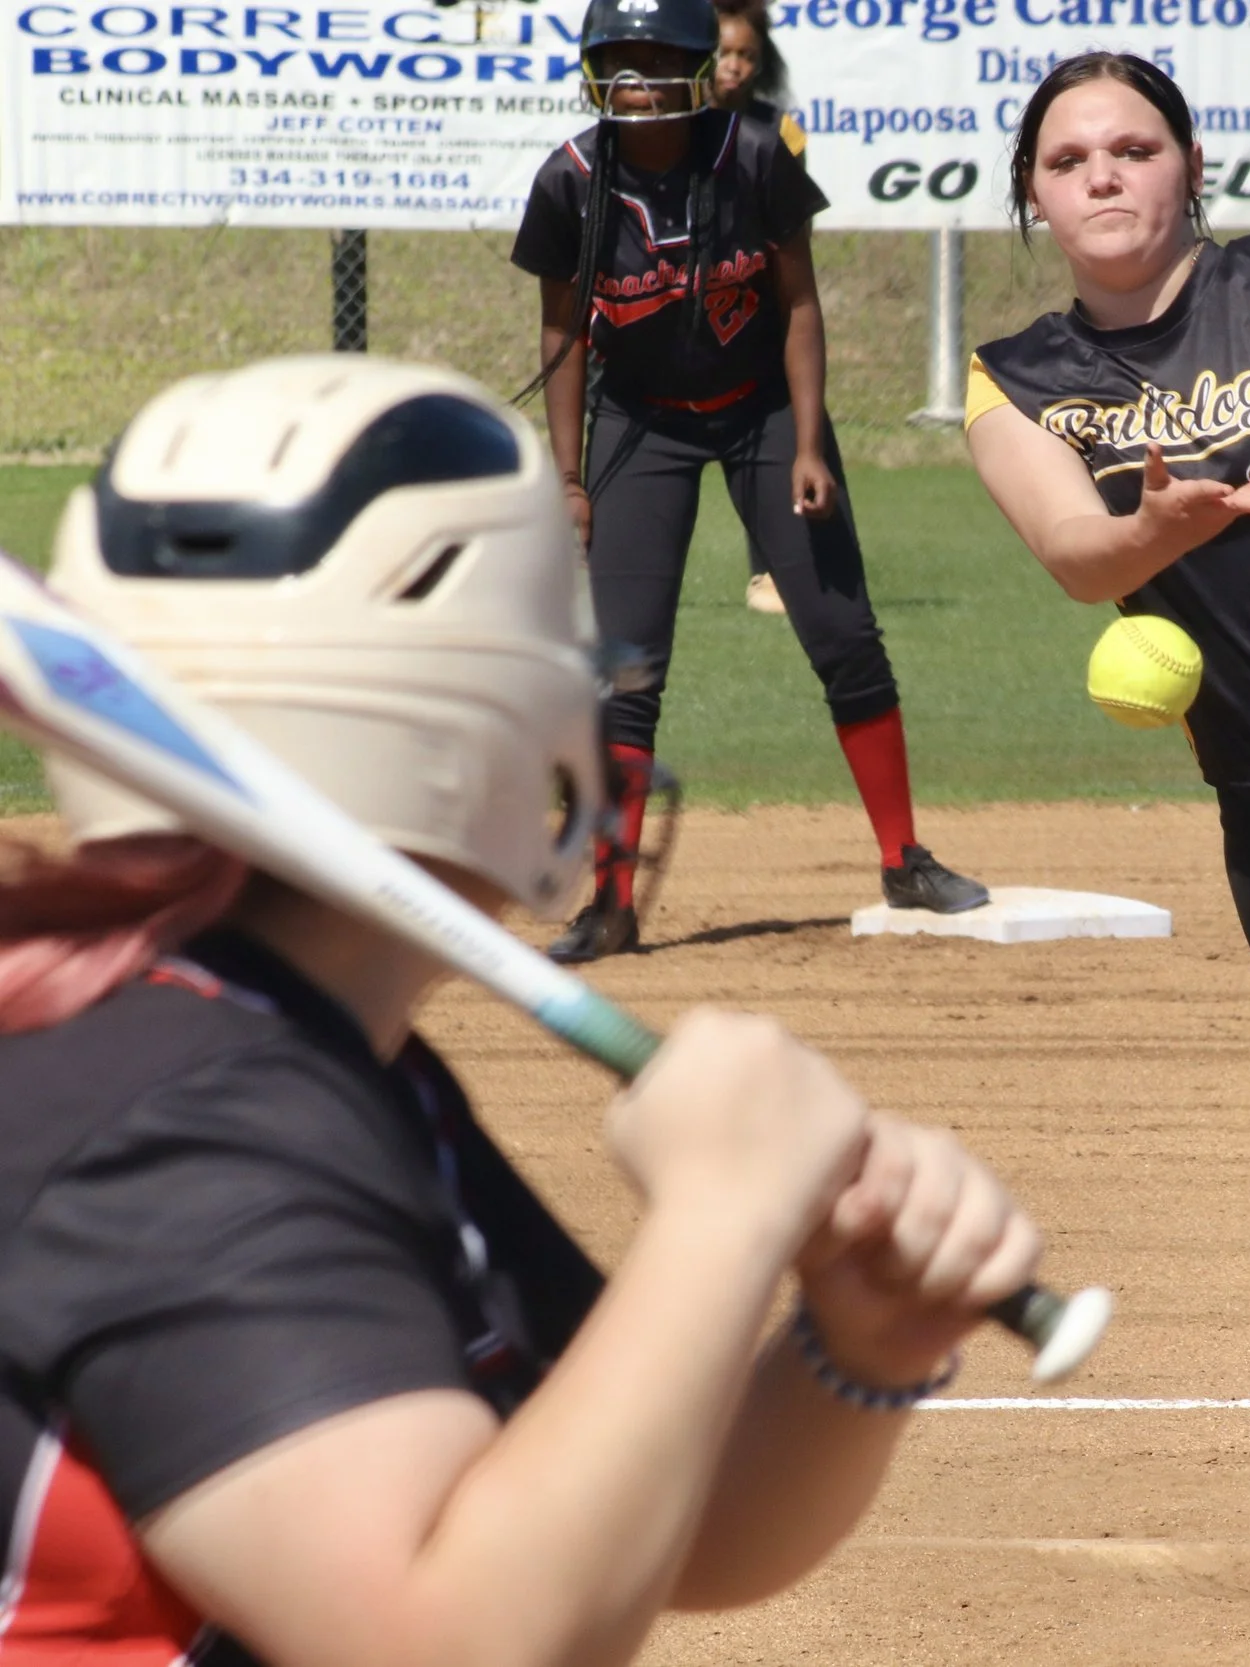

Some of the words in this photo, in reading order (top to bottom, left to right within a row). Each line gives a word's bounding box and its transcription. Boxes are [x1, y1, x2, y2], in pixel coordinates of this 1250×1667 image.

[17, 5, 582, 44] CORRECIV
[32, 47, 582, 82] BODYWORK
[1152, 46, 1176, 81] 5
[59, 88, 190, 106] CLINICAL
[203, 90, 336, 110] MASSAGE
[373, 95, 484, 112] SPORTS
[496, 96, 585, 114] MEDIC
[266, 115, 329, 132] JEFF
[338, 117, 443, 134] COTTEN
[789, 98, 978, 143] allapoosa
[229, 167, 470, 189] 334-319-1684
[868, 158, 978, 202] GO
